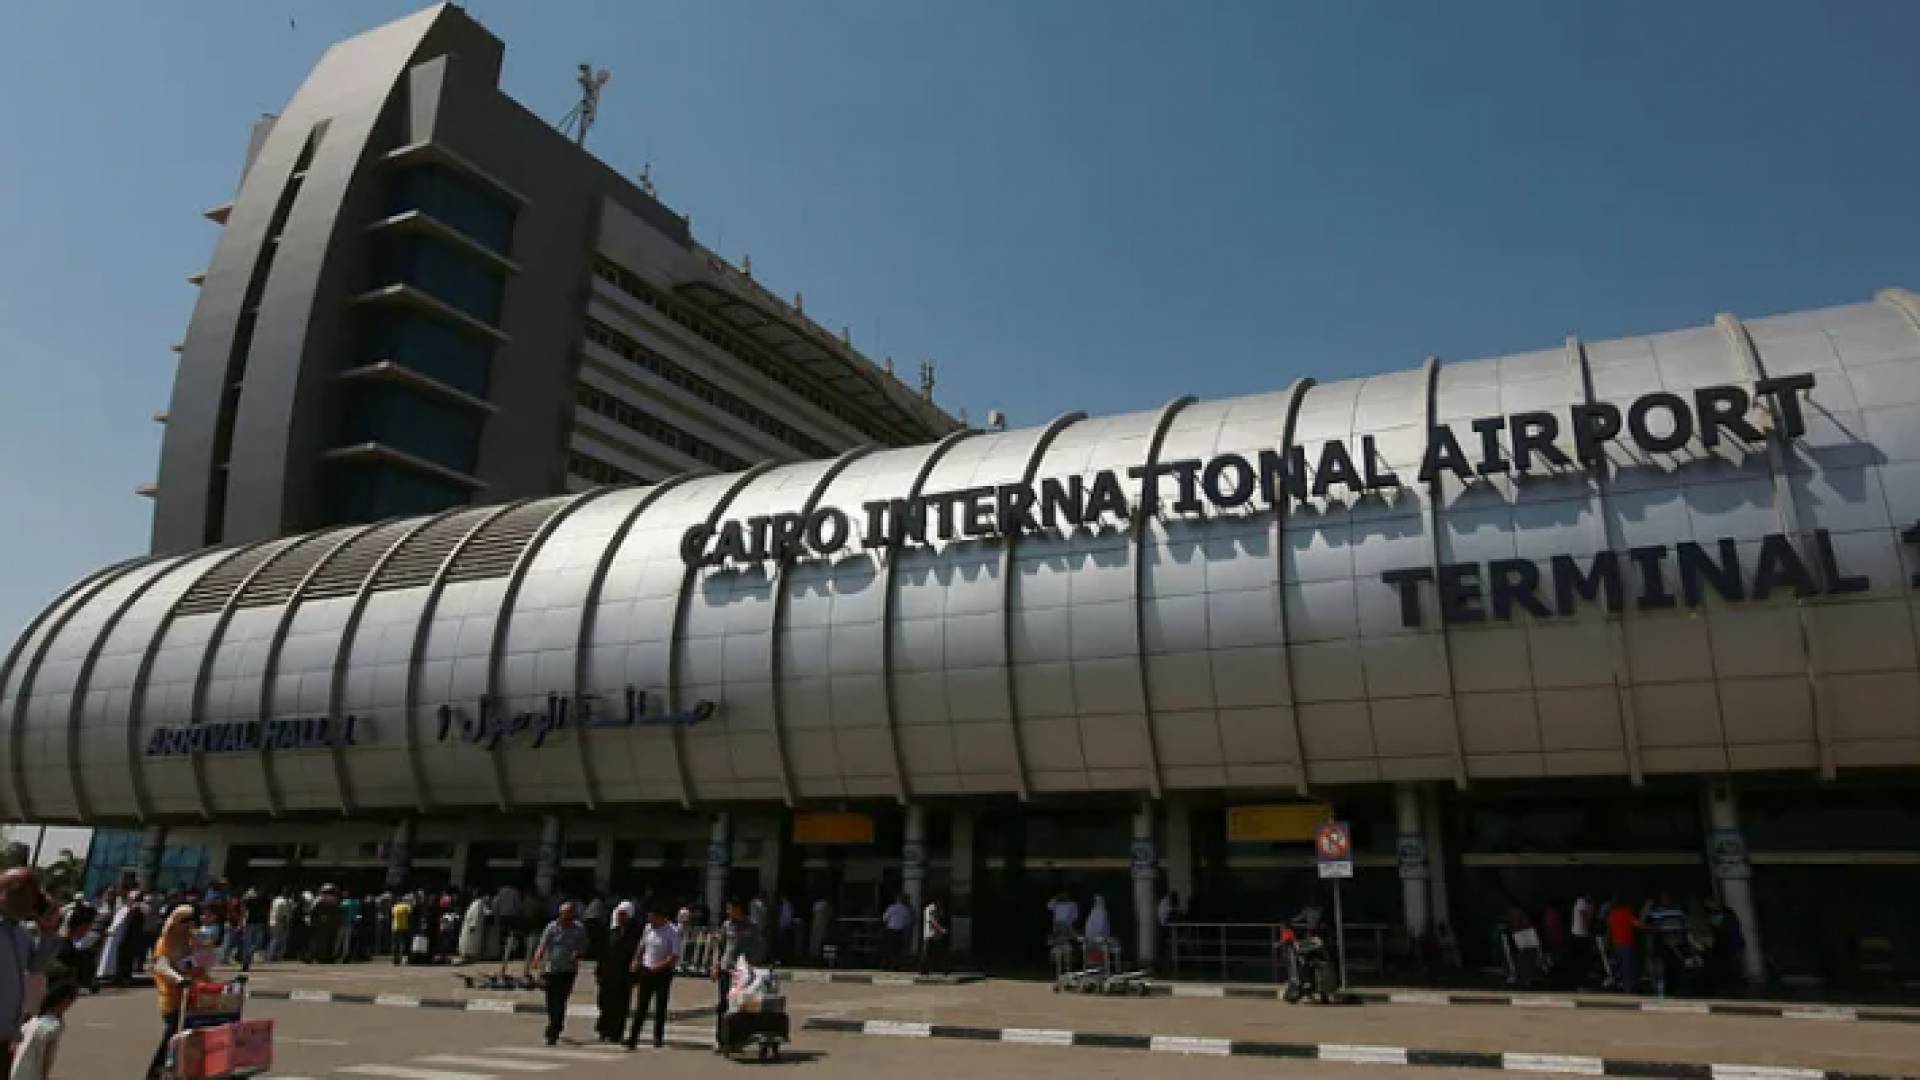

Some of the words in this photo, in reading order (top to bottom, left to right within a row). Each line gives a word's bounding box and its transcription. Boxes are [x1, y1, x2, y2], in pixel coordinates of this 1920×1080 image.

[680, 507, 849, 568] CAIRO
[861, 434, 1399, 547] INTERNATIONAL
[1418, 373, 1816, 482] AIRPORT
[1382, 528, 1870, 627] TERMINAL
[145, 720, 261, 756] ARRIVAL
